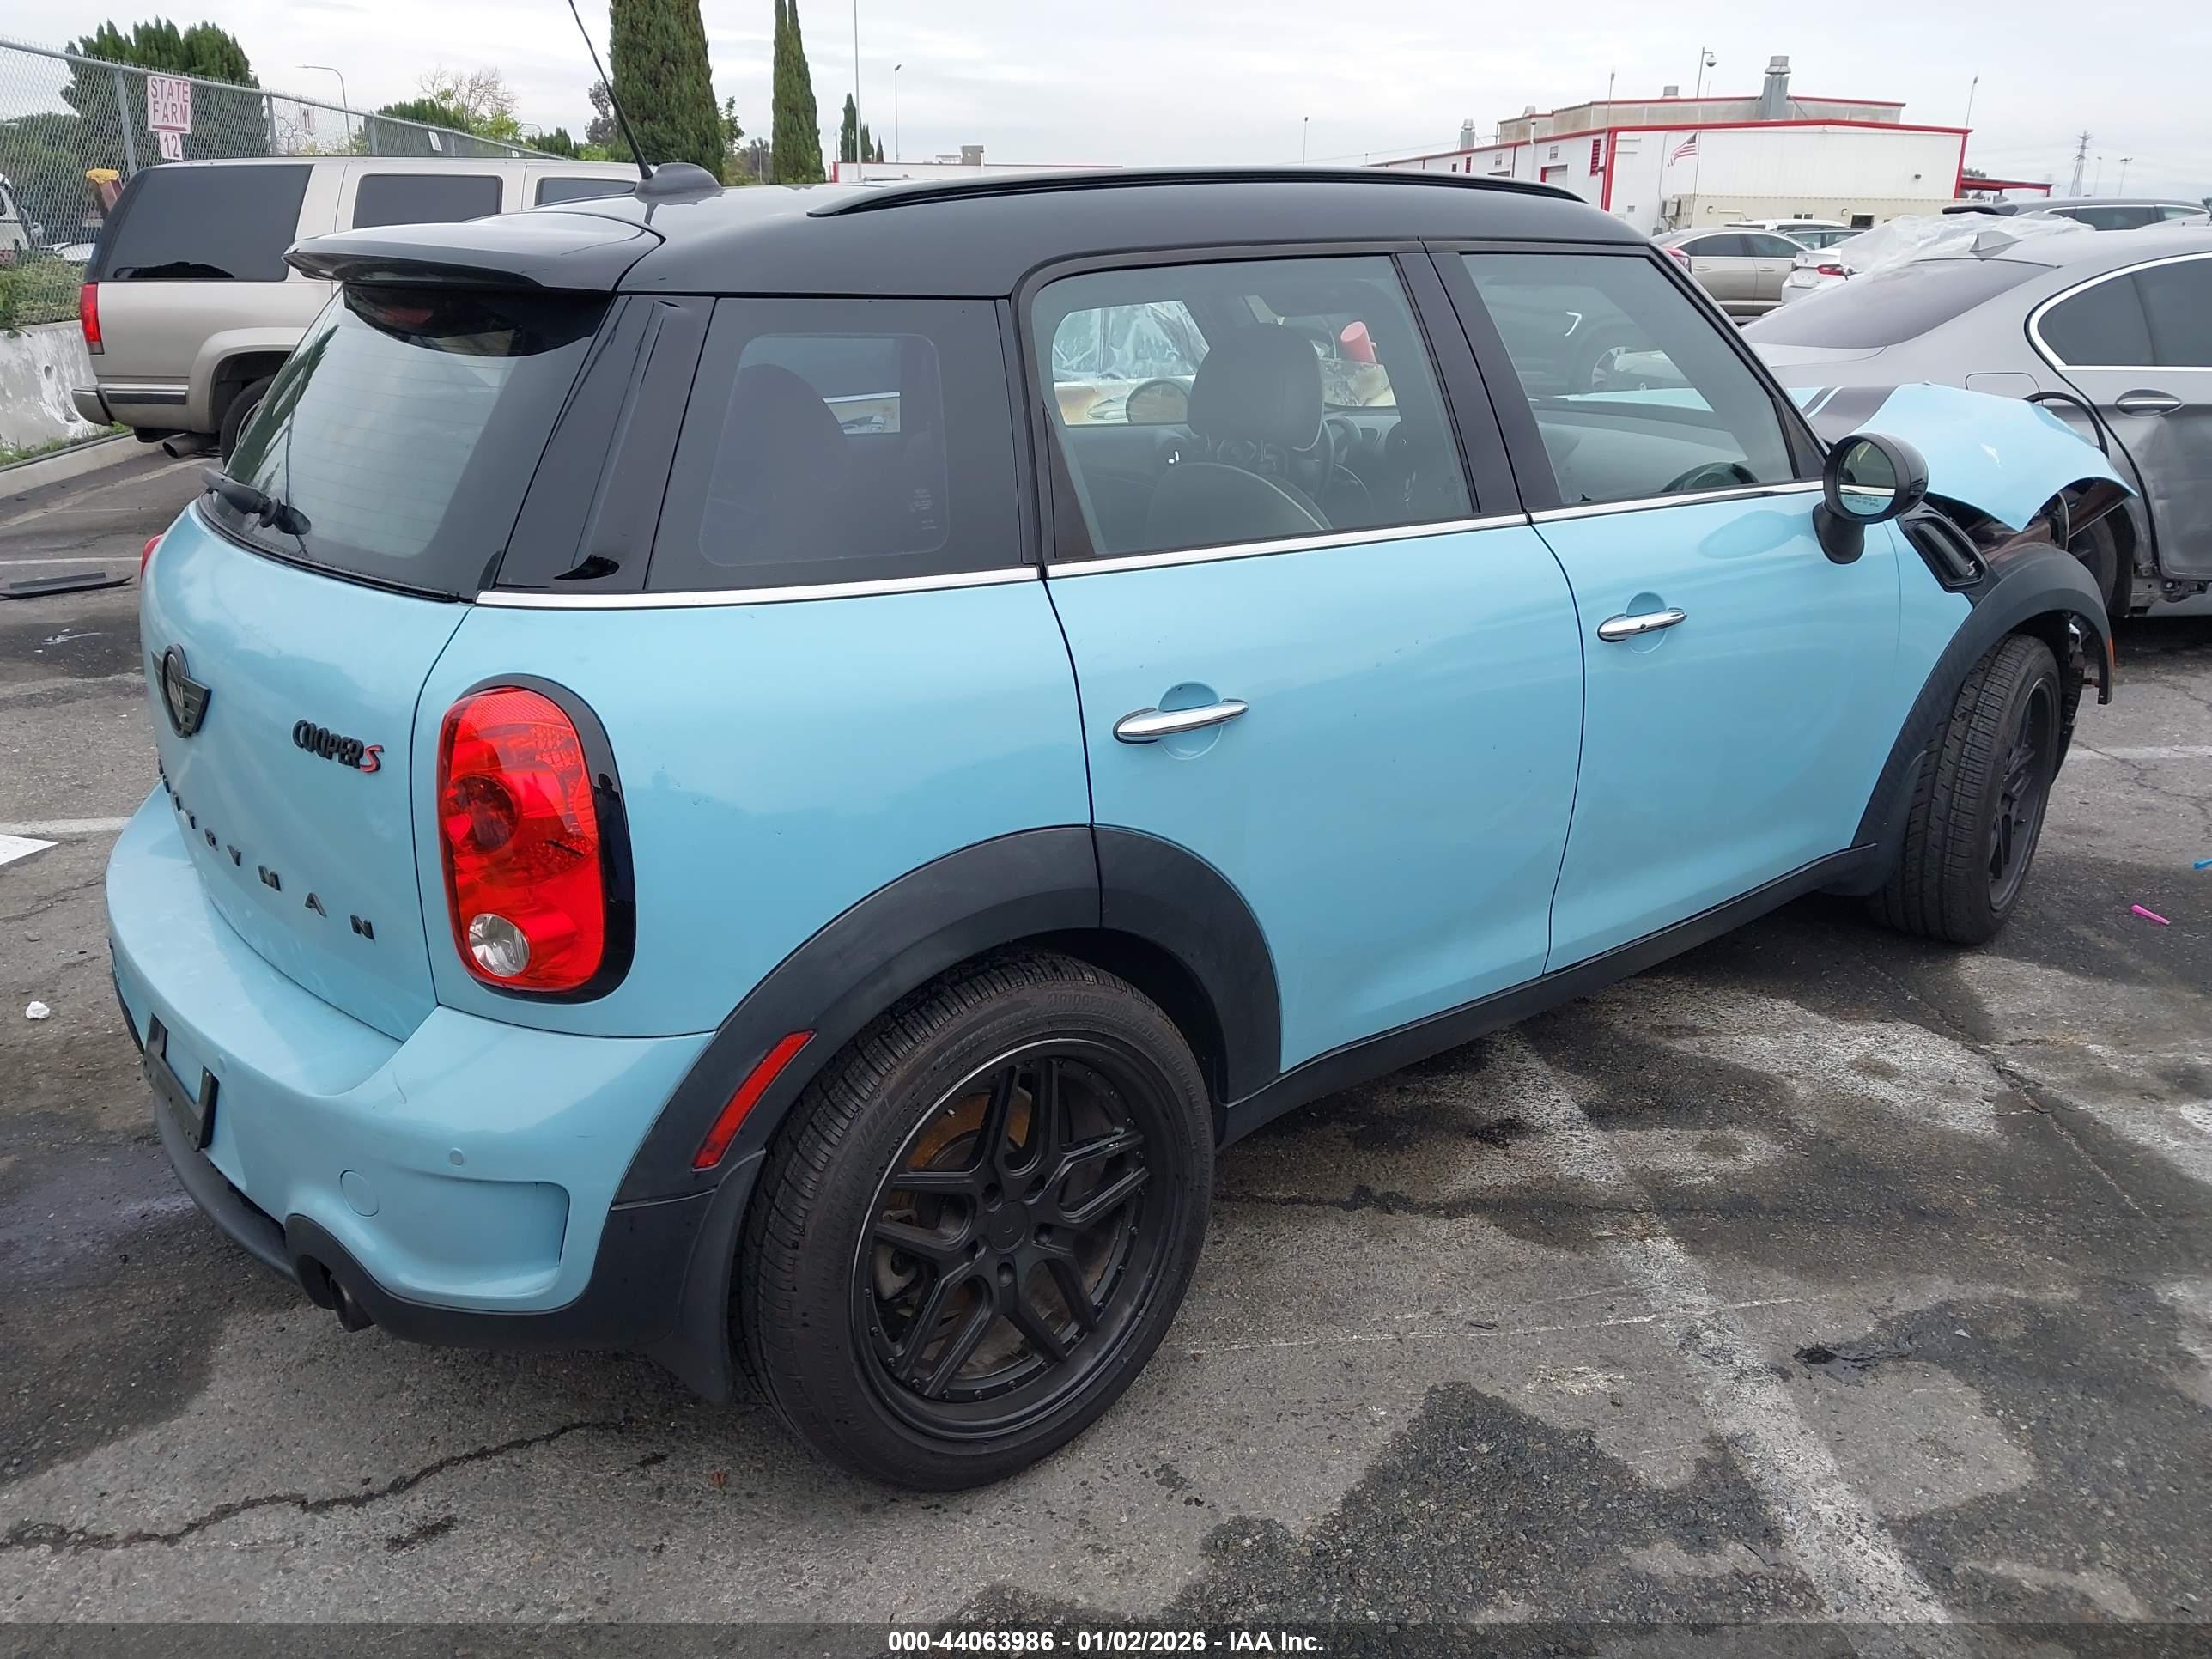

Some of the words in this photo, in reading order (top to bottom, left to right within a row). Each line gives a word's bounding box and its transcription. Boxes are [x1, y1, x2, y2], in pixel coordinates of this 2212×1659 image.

[151, 78, 189, 103] STATE
[153, 100, 188, 125] FARM
[164, 133, 179, 158] 12
